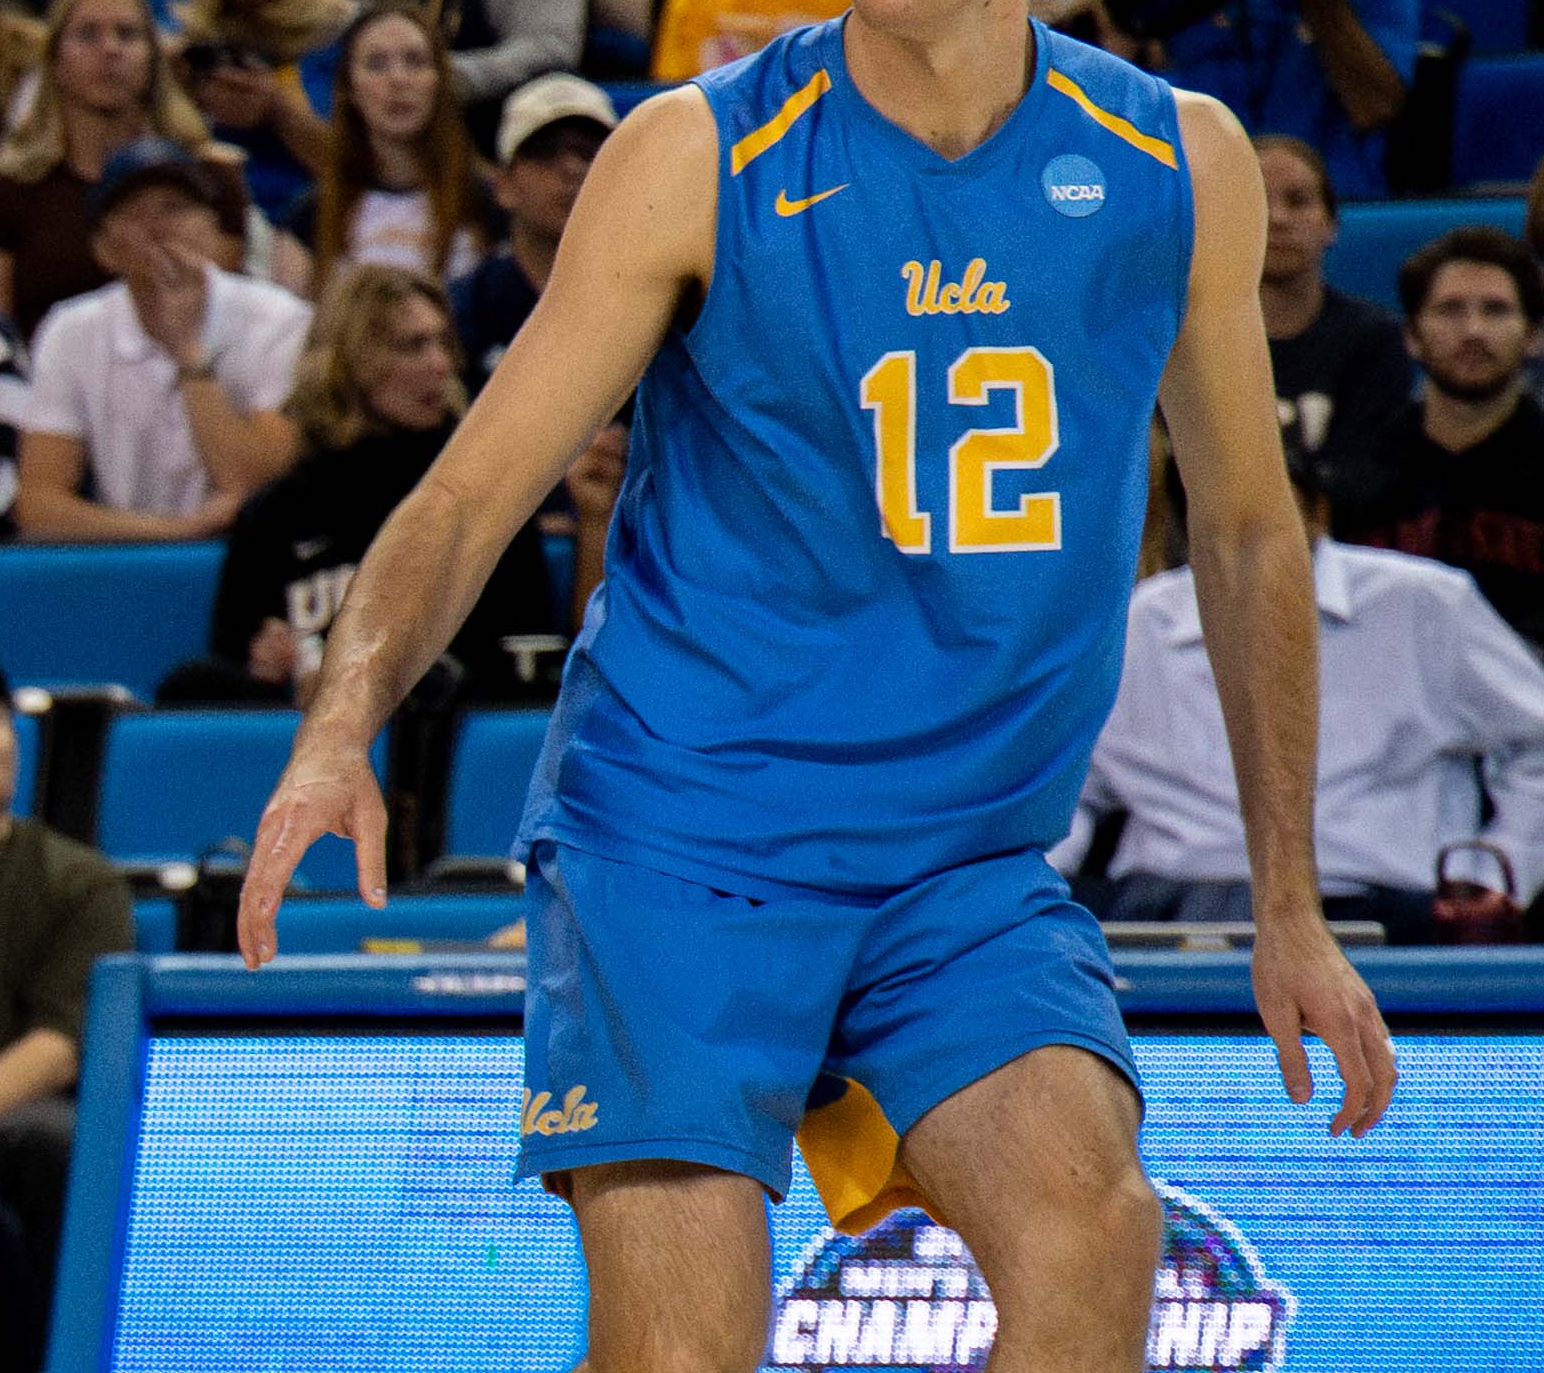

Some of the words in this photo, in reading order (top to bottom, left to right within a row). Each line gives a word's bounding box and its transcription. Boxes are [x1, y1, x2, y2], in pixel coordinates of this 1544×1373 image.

[1050, 183, 1105, 202] NCAA
[901, 257, 1011, 316] Ucla
[859, 345, 1062, 556] 12
[772, 1299, 1272, 1366] CHAMPHIP
